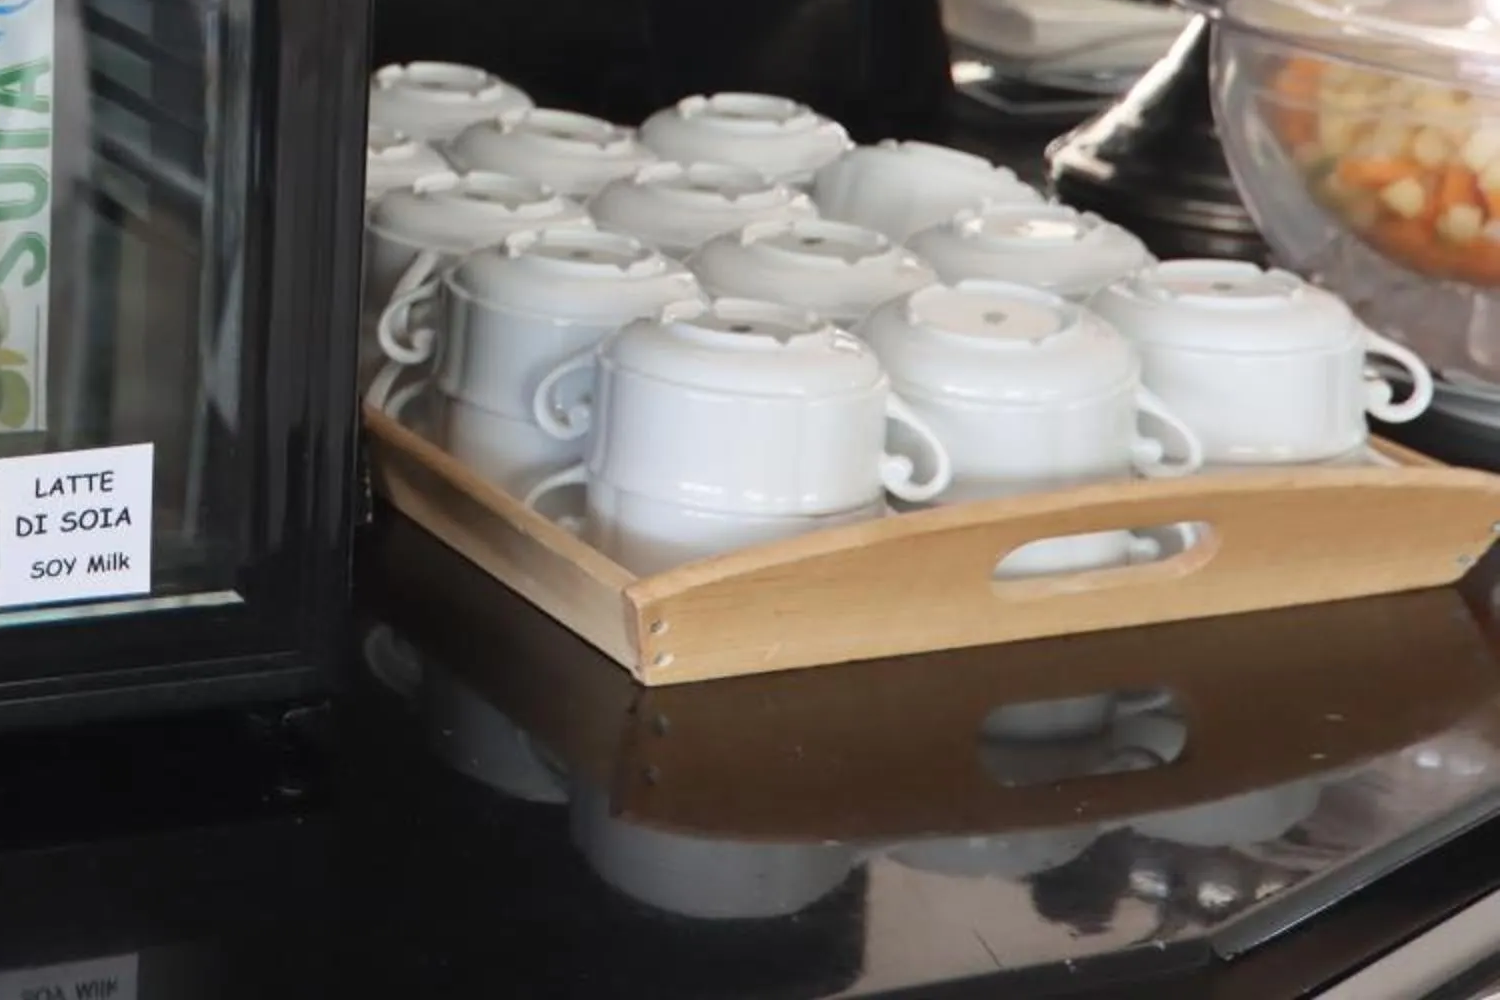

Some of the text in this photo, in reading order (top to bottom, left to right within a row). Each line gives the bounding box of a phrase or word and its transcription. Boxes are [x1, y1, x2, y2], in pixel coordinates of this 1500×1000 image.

[35, 470, 115, 498] LATTE
[16, 506, 132, 537] DI SOIA
[30, 551, 131, 579] SOY Milk
